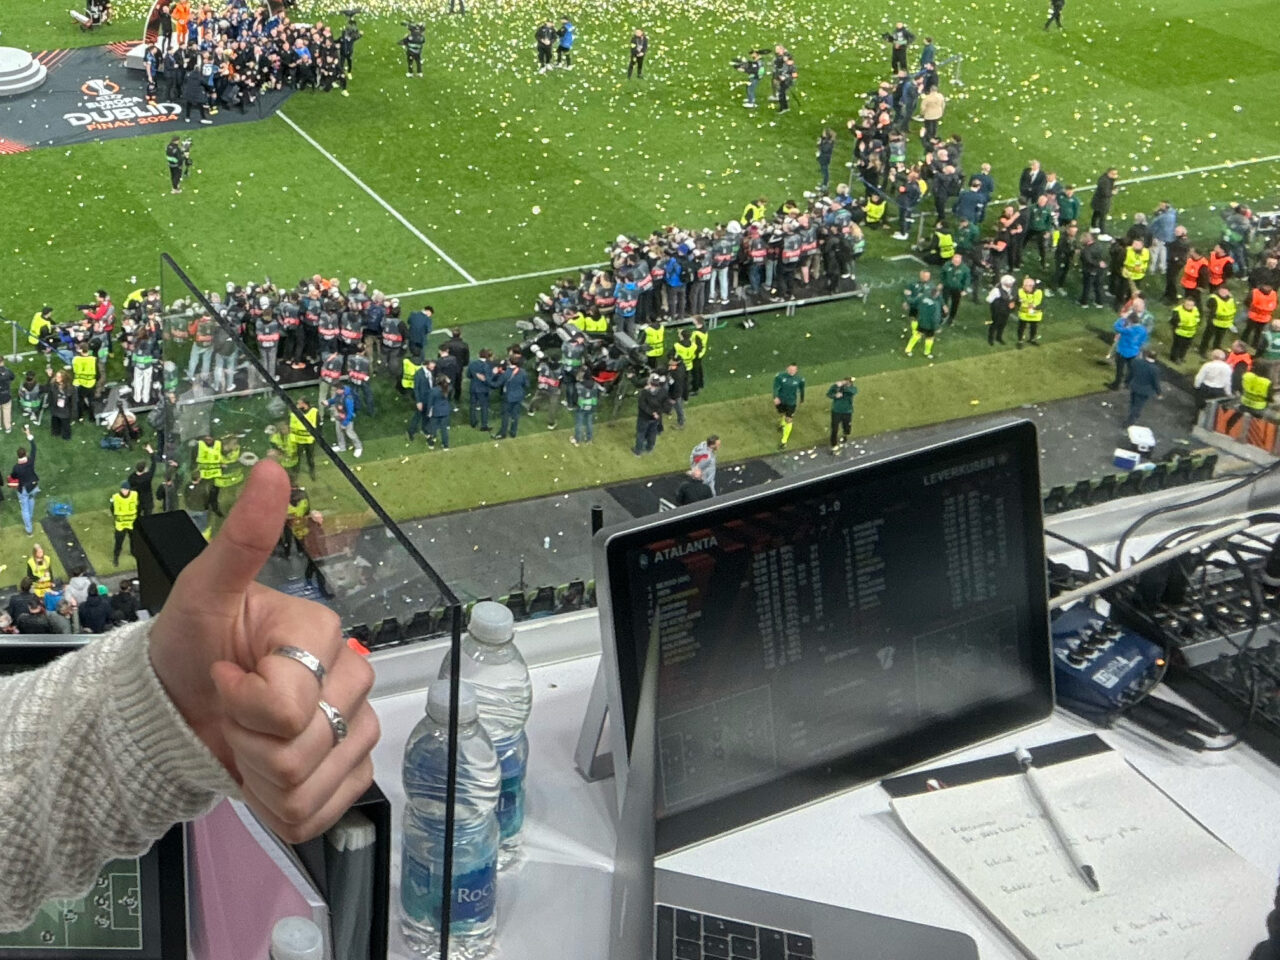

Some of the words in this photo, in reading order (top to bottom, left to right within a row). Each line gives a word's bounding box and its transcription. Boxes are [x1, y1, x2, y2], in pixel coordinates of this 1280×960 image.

[63, 103, 182, 127] DUBLIN
[86, 120, 136, 132] FINAL
[137, 114, 179, 125] 2024
[654, 536, 719, 564] ATALANTA
